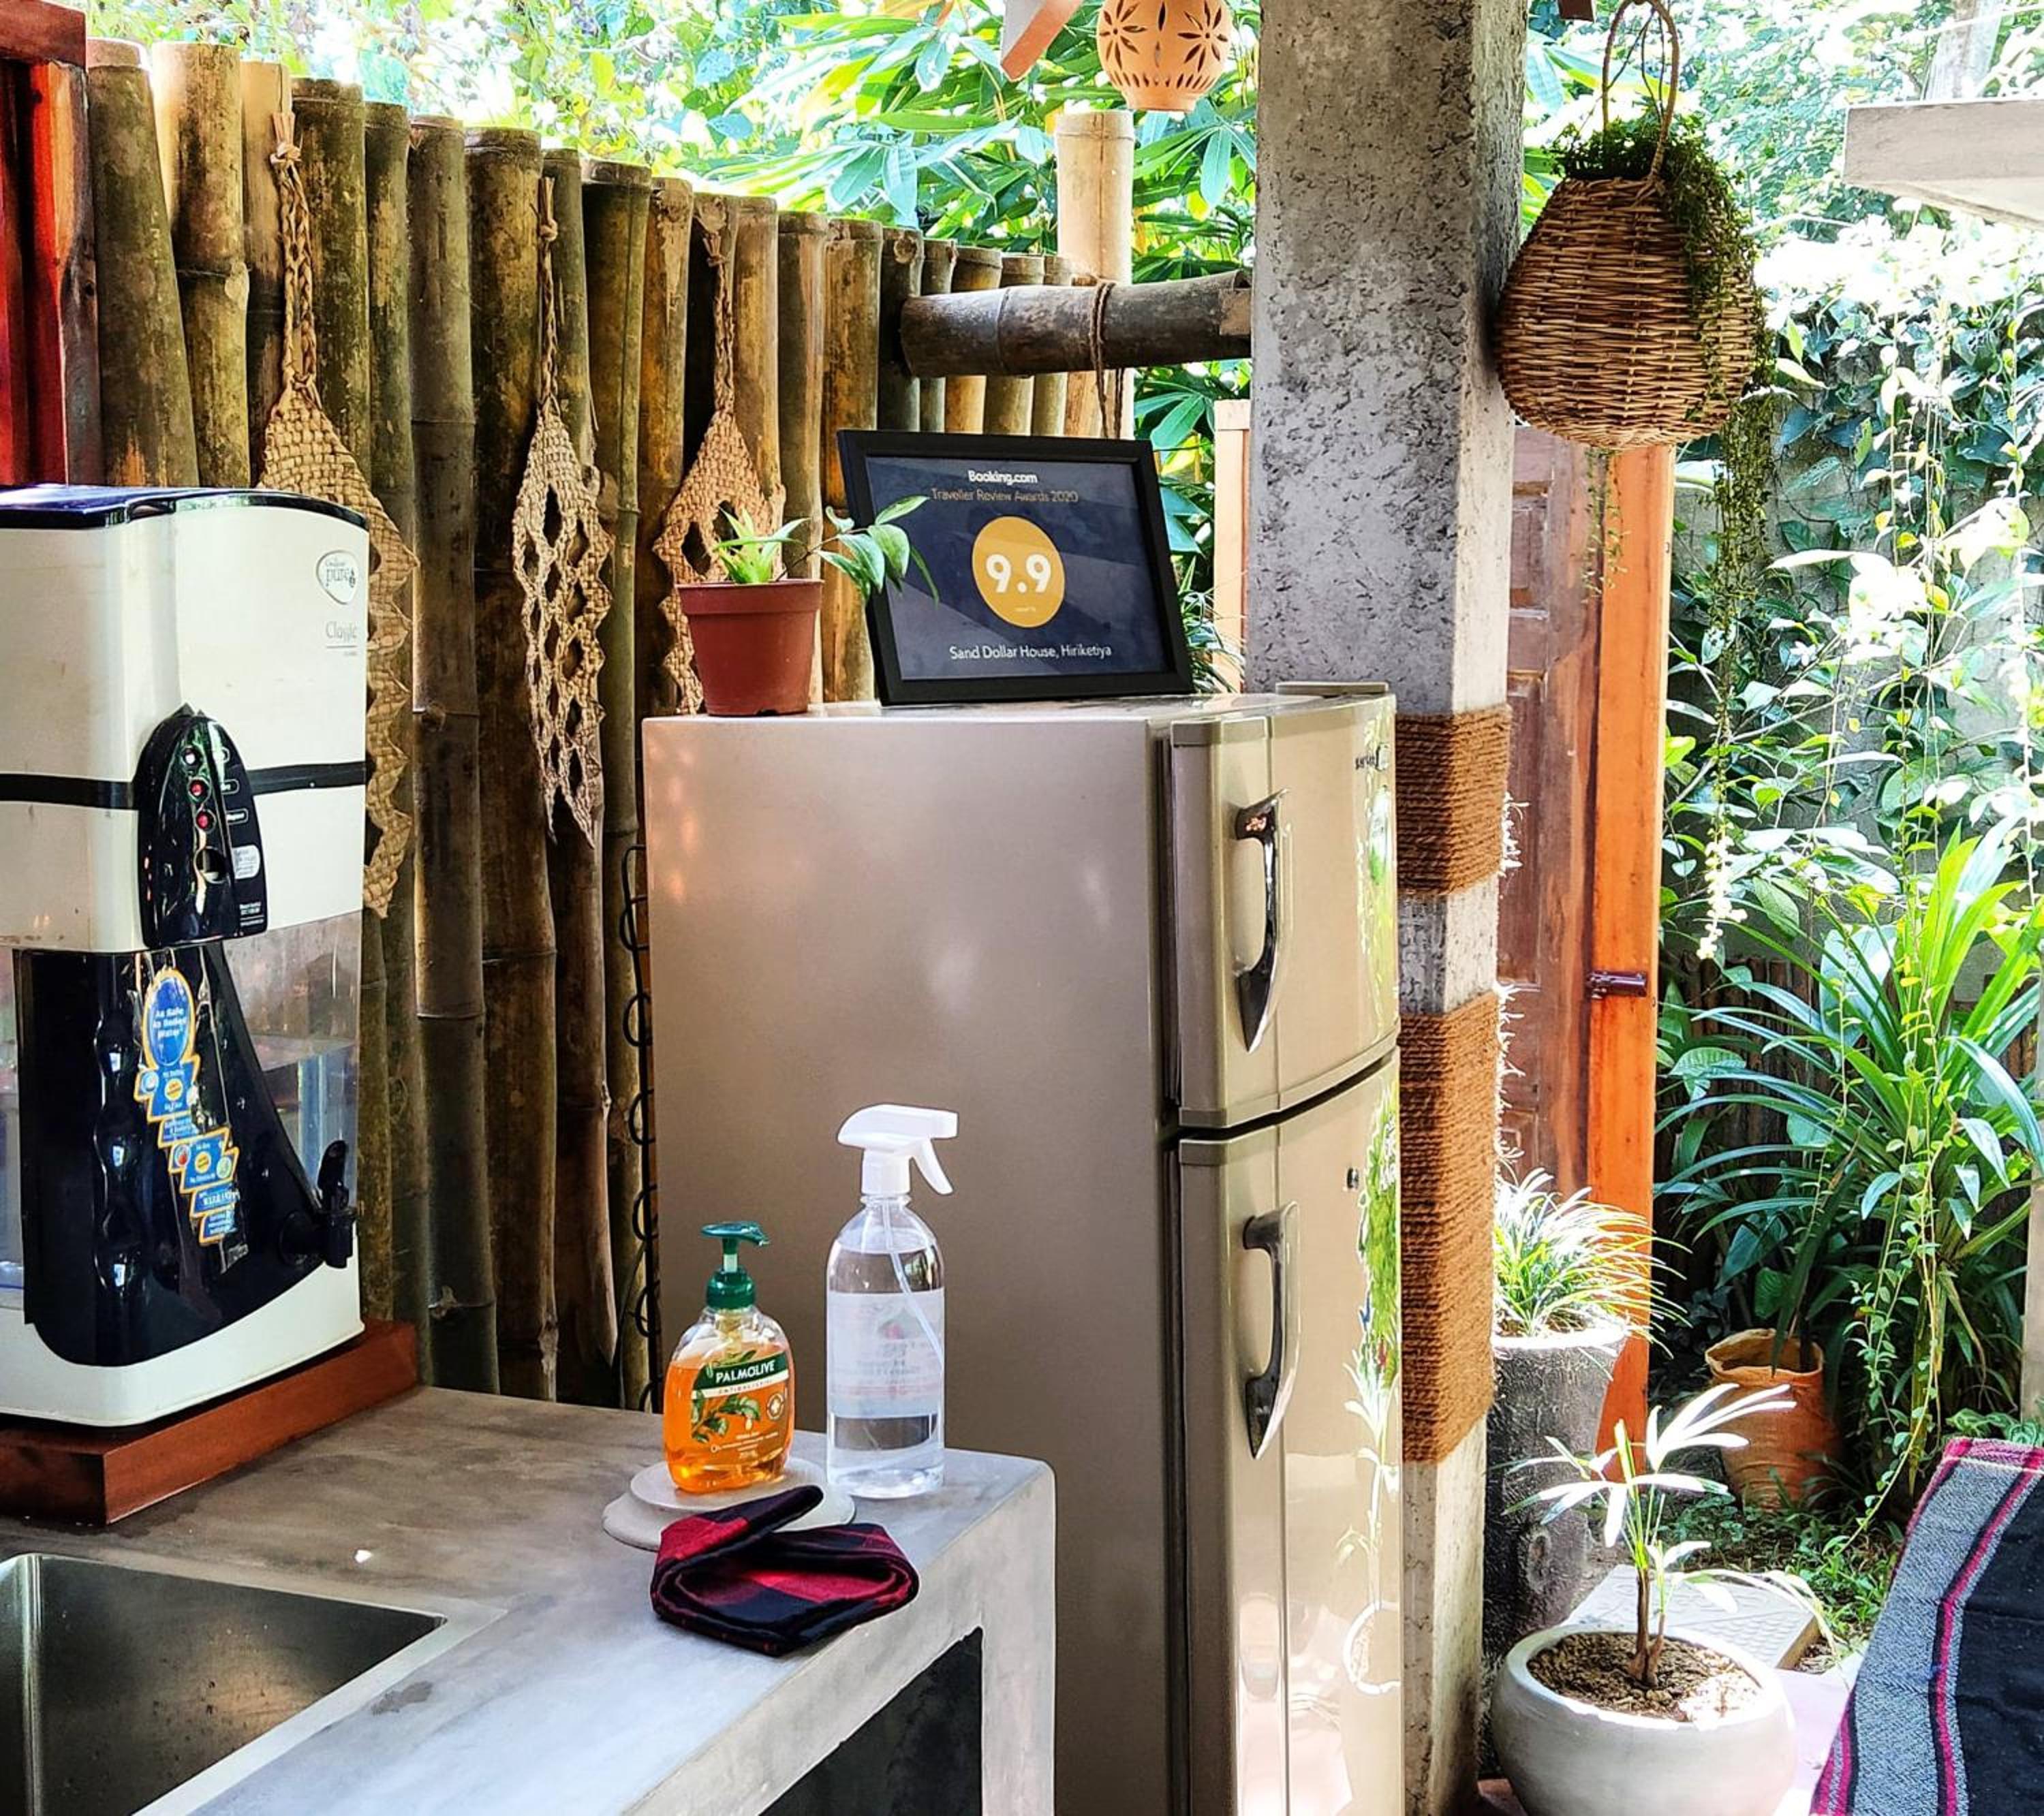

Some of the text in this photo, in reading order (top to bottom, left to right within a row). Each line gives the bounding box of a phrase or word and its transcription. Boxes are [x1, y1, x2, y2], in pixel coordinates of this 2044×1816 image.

[967, 469, 1038, 485] Booking.com
[931, 488, 1079, 503] Traveller Review Awards 2020
[985, 554, 1051, 593] 9.9
[949, 643, 1112, 659] Sand Dollar House, Hiriketiya
[715, 1360, 776, 1384] PALMOLIVE
